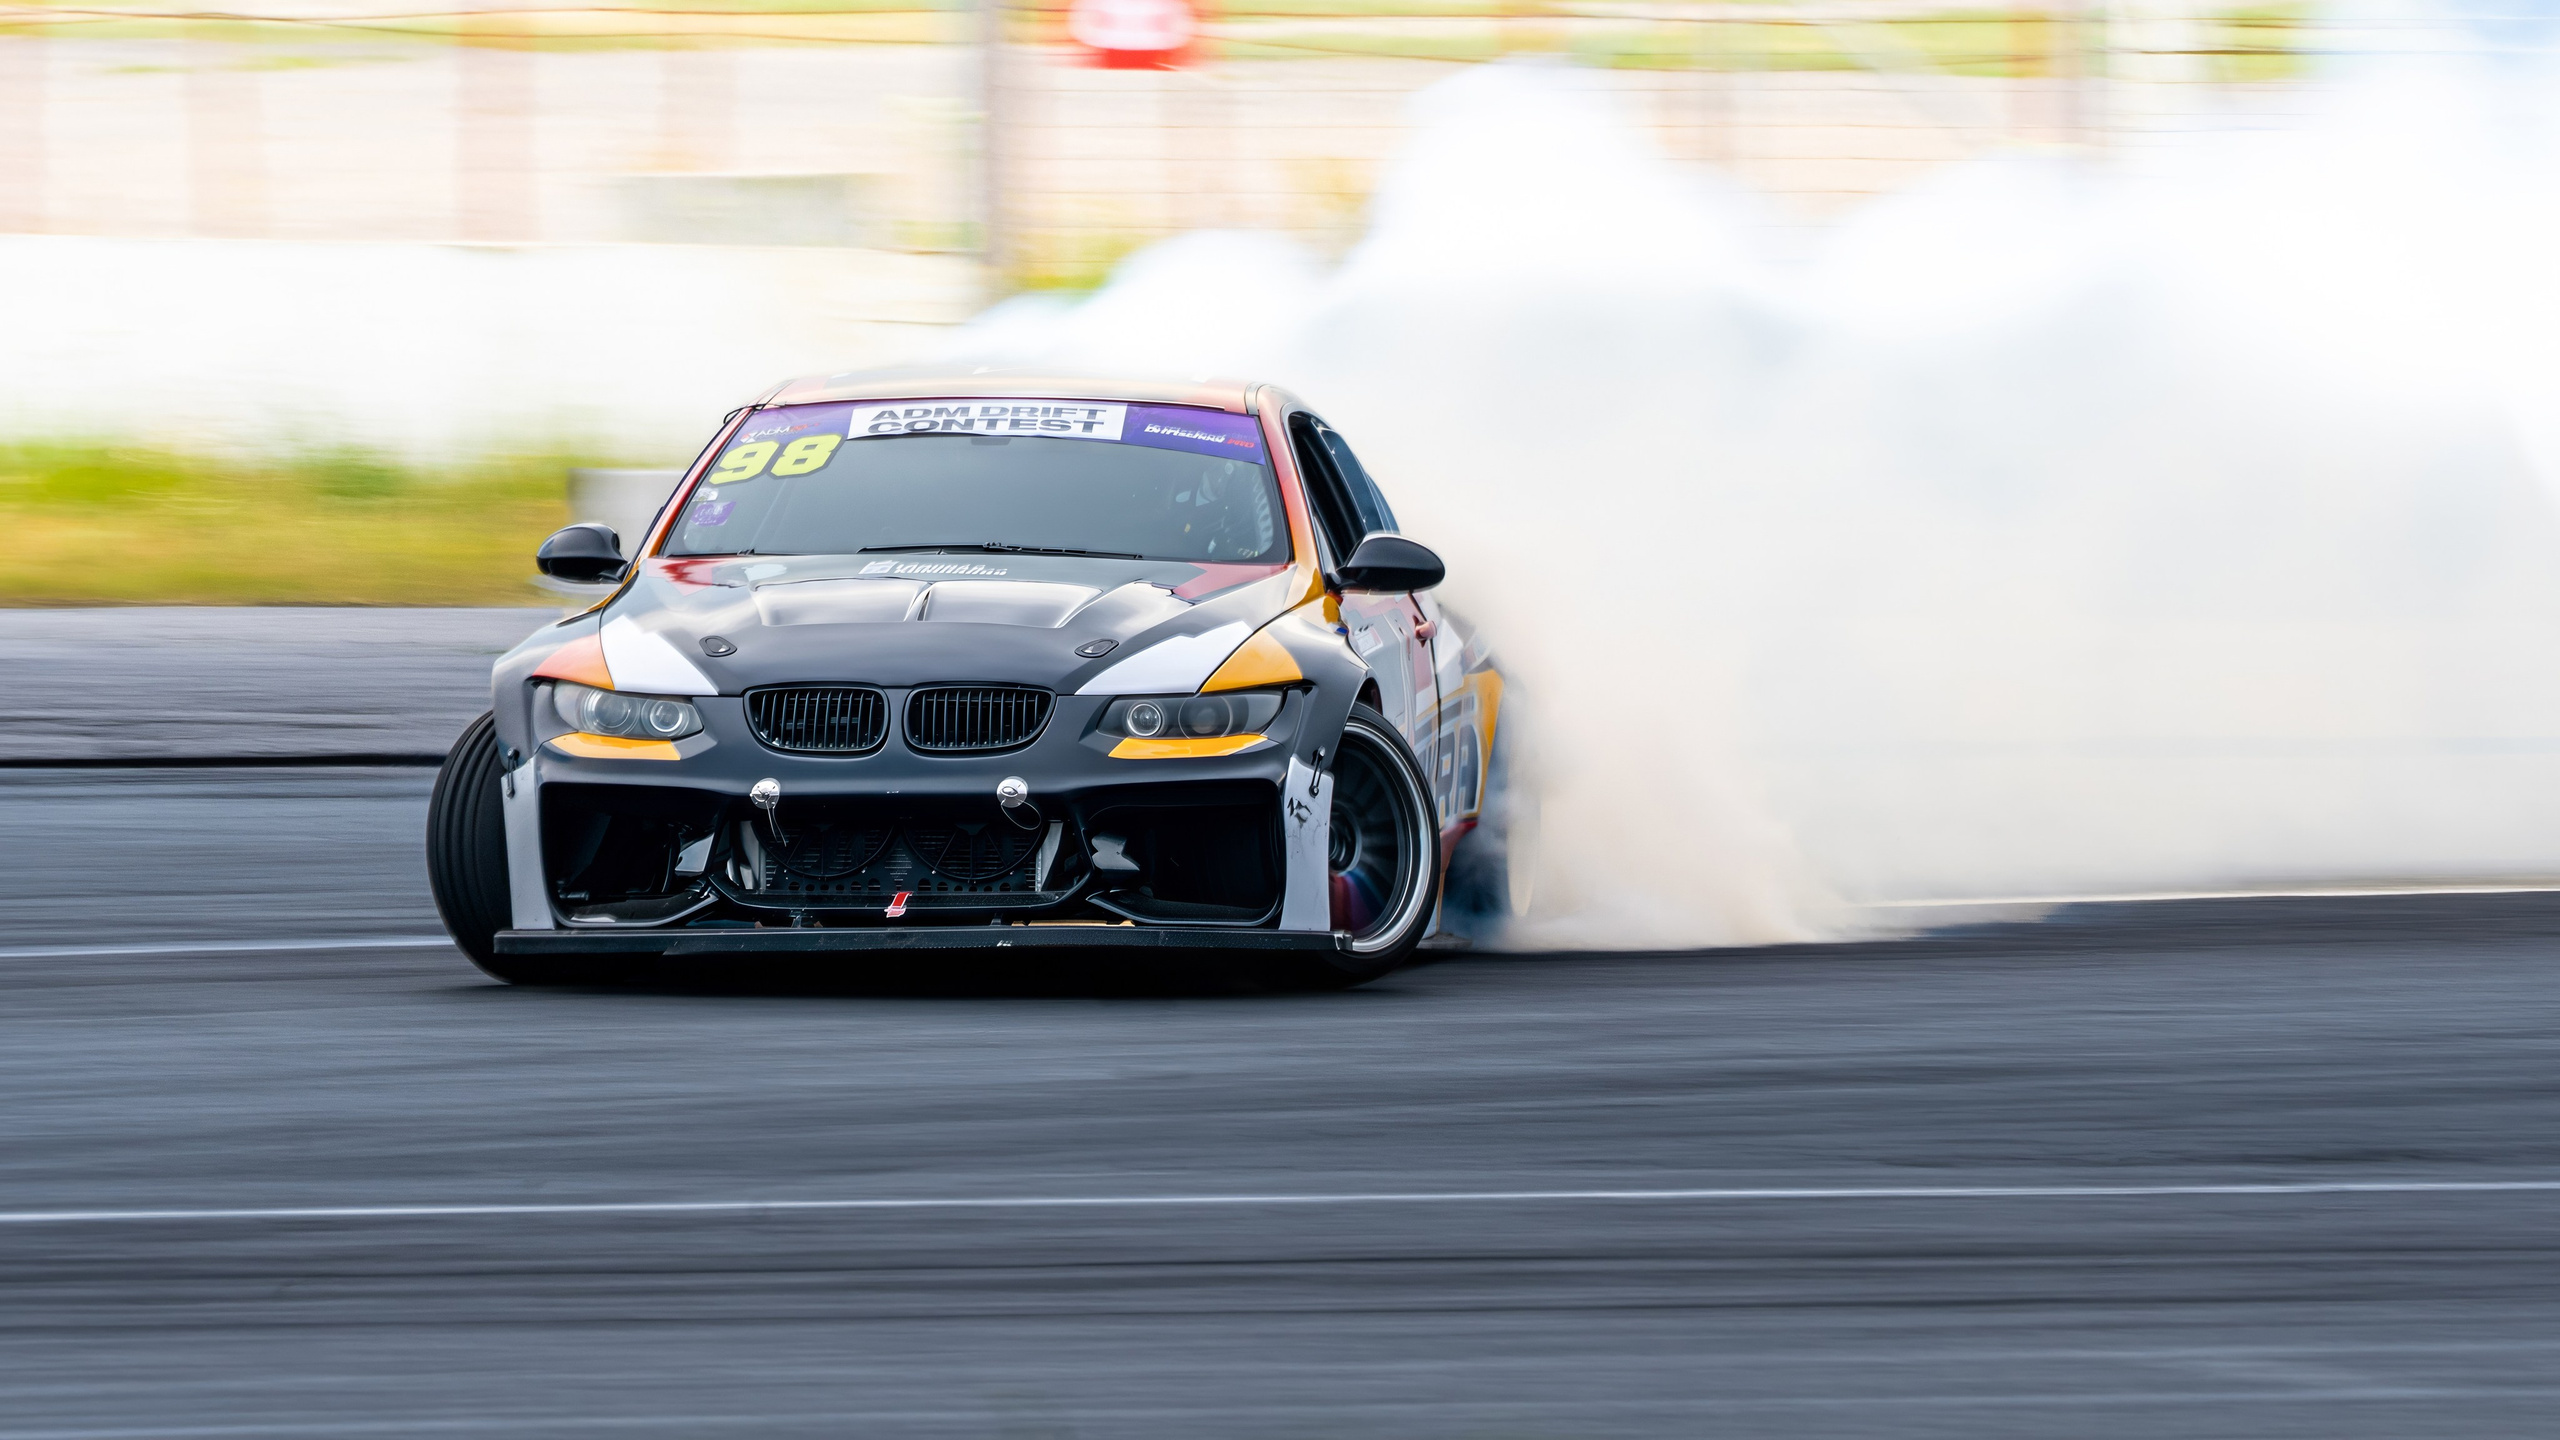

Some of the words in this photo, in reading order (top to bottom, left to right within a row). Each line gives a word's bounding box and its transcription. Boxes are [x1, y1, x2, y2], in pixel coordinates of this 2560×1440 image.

[870, 406, 970, 421] ADM
[980, 406, 1107, 420] DRIFT
[867, 418, 1105, 434] CONTEST
[708, 433, 843, 486] 98
